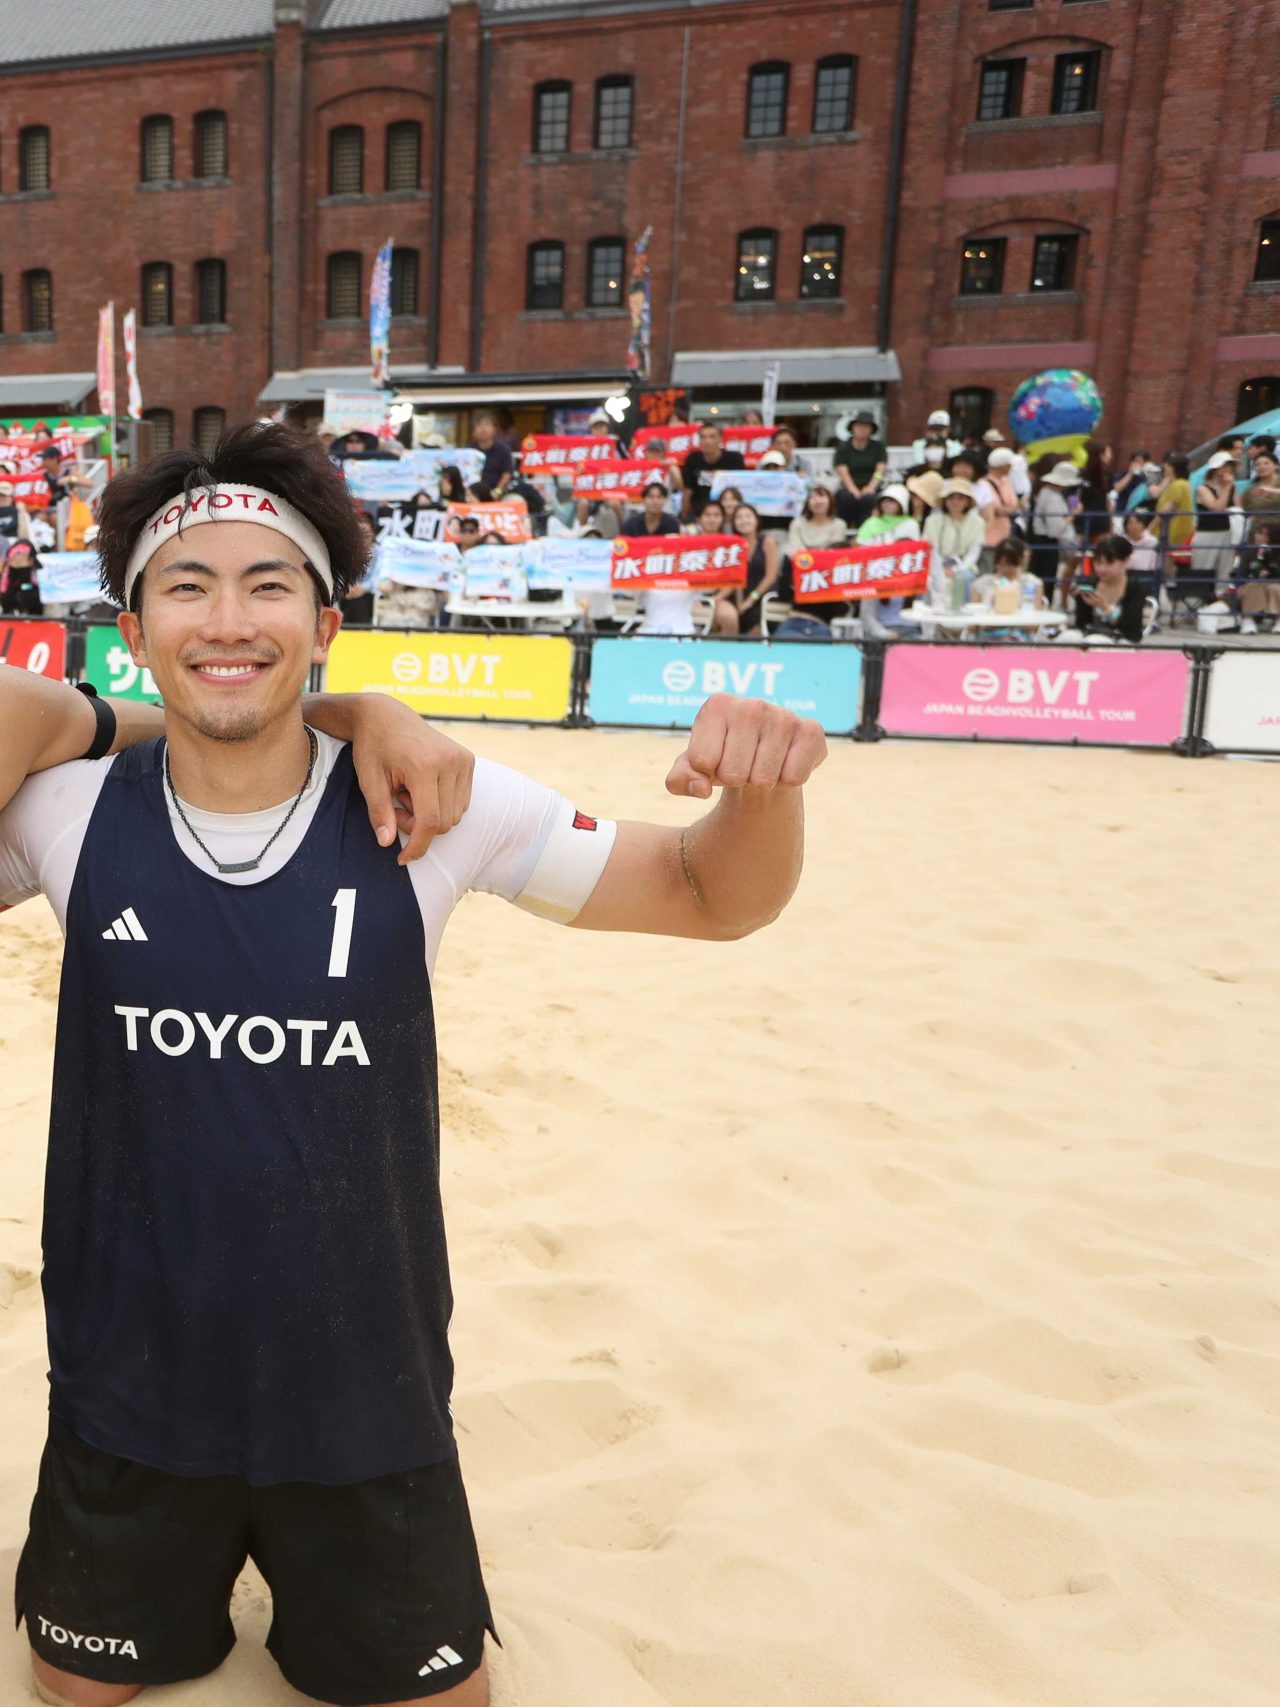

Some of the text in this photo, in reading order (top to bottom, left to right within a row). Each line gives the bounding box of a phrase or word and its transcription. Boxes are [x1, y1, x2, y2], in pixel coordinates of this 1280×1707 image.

[149, 493, 279, 536] TOYOTA
[428, 653, 502, 685] BVT
[702, 660, 784, 695] BVT
[1007, 668, 1100, 705] BVT
[923, 703, 1137, 722] JAPAN BEACHVOLLEYBALL TOUR
[327, 888, 357, 978] 1
[114, 1004, 372, 1066] TOYOTA
[37, 1615, 139, 1660] TOYOTA
